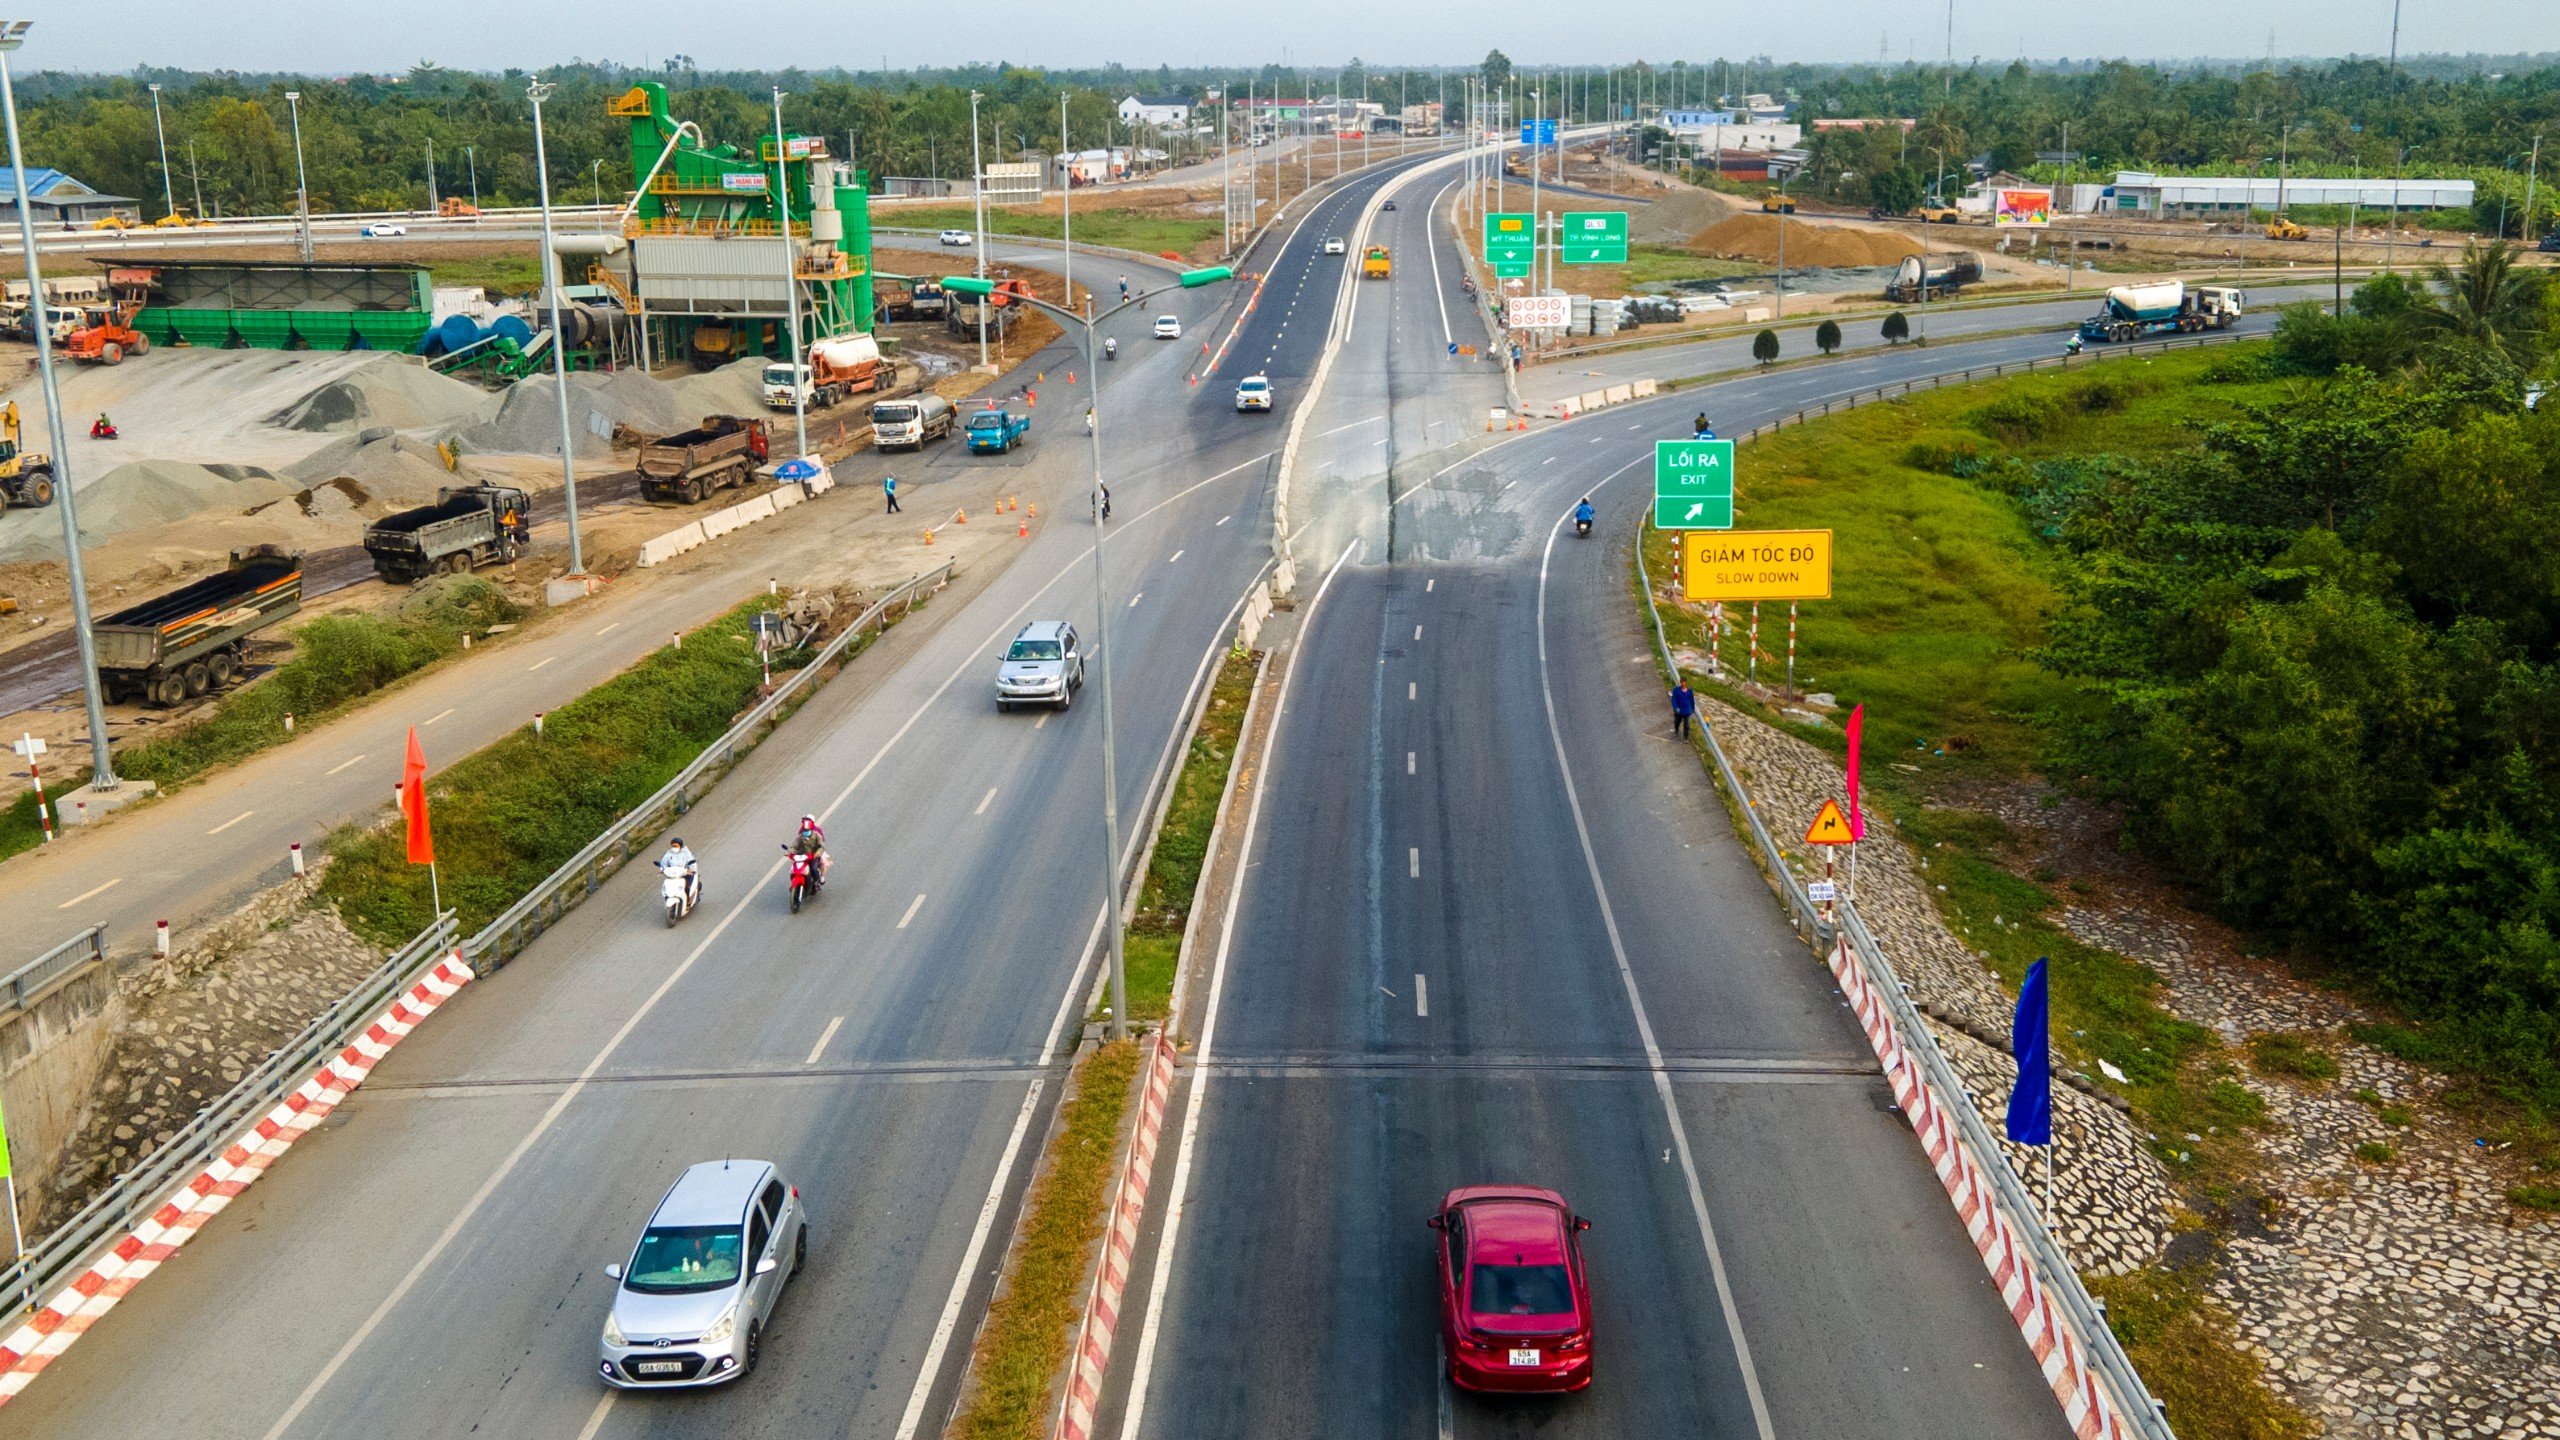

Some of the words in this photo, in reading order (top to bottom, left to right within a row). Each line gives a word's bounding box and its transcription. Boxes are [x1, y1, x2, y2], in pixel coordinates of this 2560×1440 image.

[1600, 233, 1621, 241] LONG
[1669, 447, 1693, 467] LỐI
[1698, 453, 1719, 467] RA
[1681, 474, 1707, 485] EXIT
[1700, 543, 1745, 563] GIẢM
[1751, 541, 1785, 562] TỐC
[1789, 543, 1814, 565] ĐỘ
[1716, 572, 1755, 584] SLOW
[1759, 571, 1799, 583] DOWN
